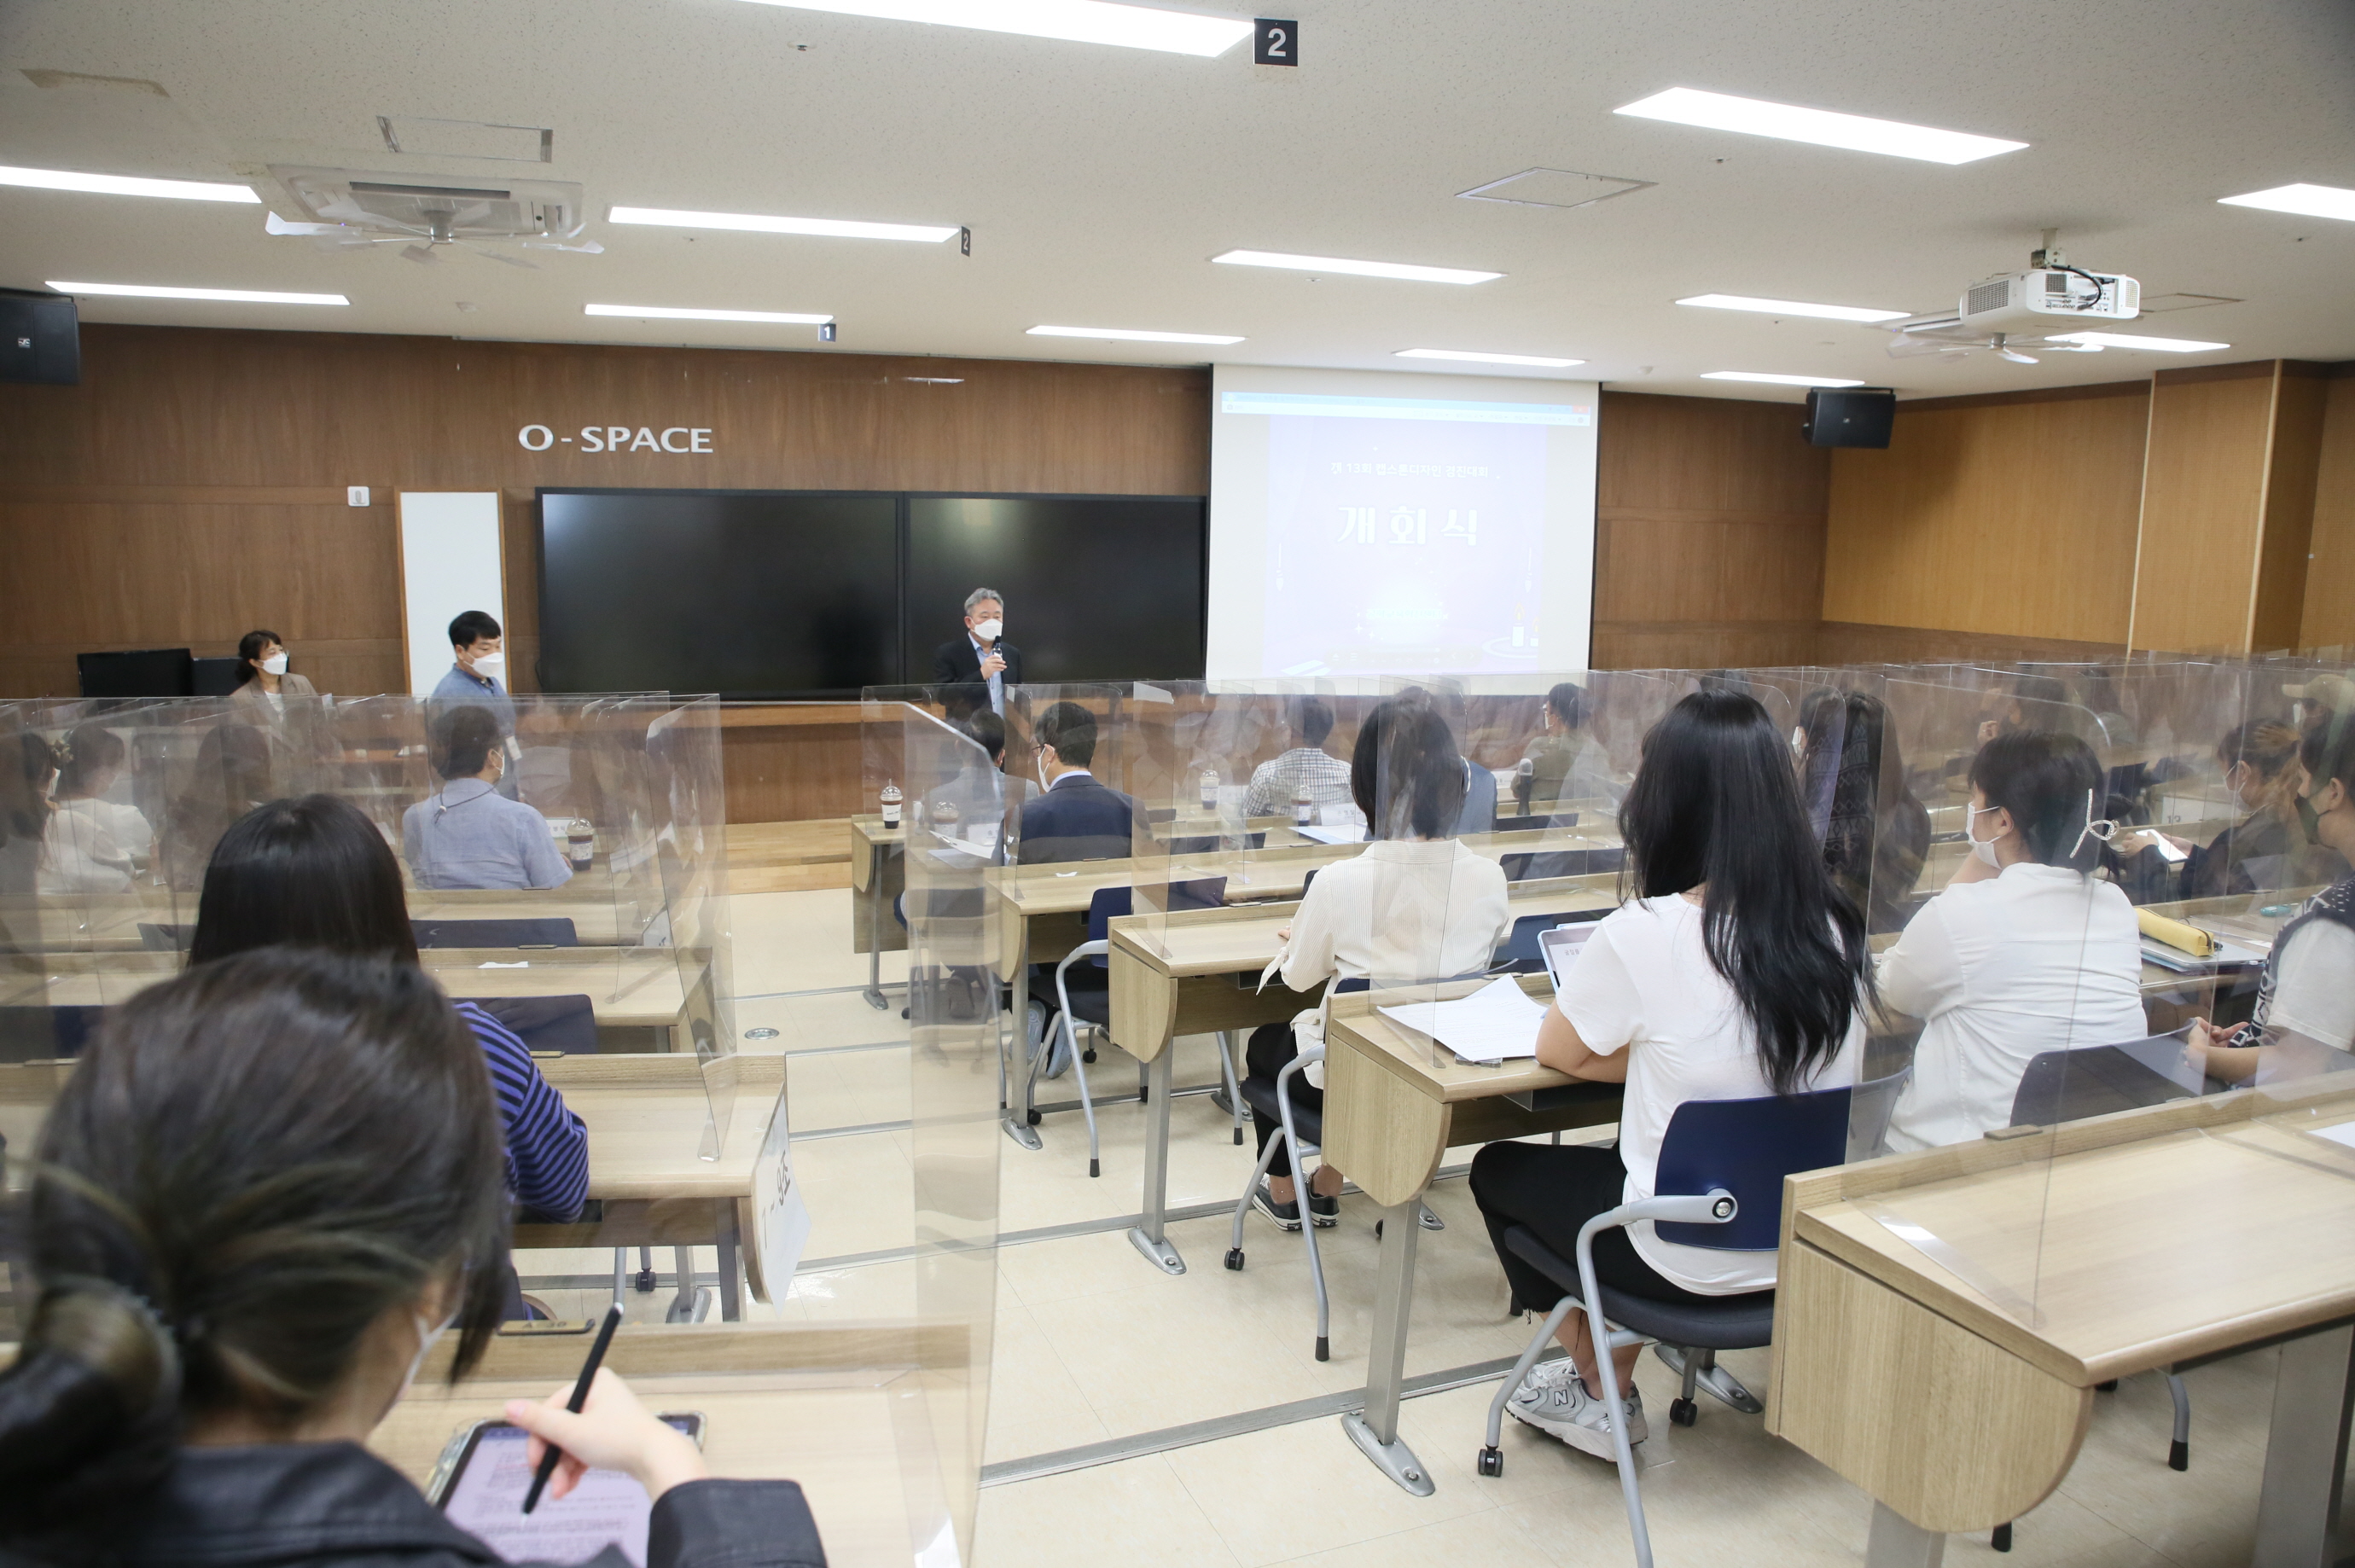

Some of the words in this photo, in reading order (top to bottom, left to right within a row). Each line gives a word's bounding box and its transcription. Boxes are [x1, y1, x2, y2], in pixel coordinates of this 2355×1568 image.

[1268, 27, 1287, 57] 2
[963, 233, 969, 251] 2
[824, 326, 831, 340] 1
[1346, 462, 1372, 474] 13회
[1445, 466, 1489, 479] 경진대회
[1554, 1389, 1569, 1407] N
